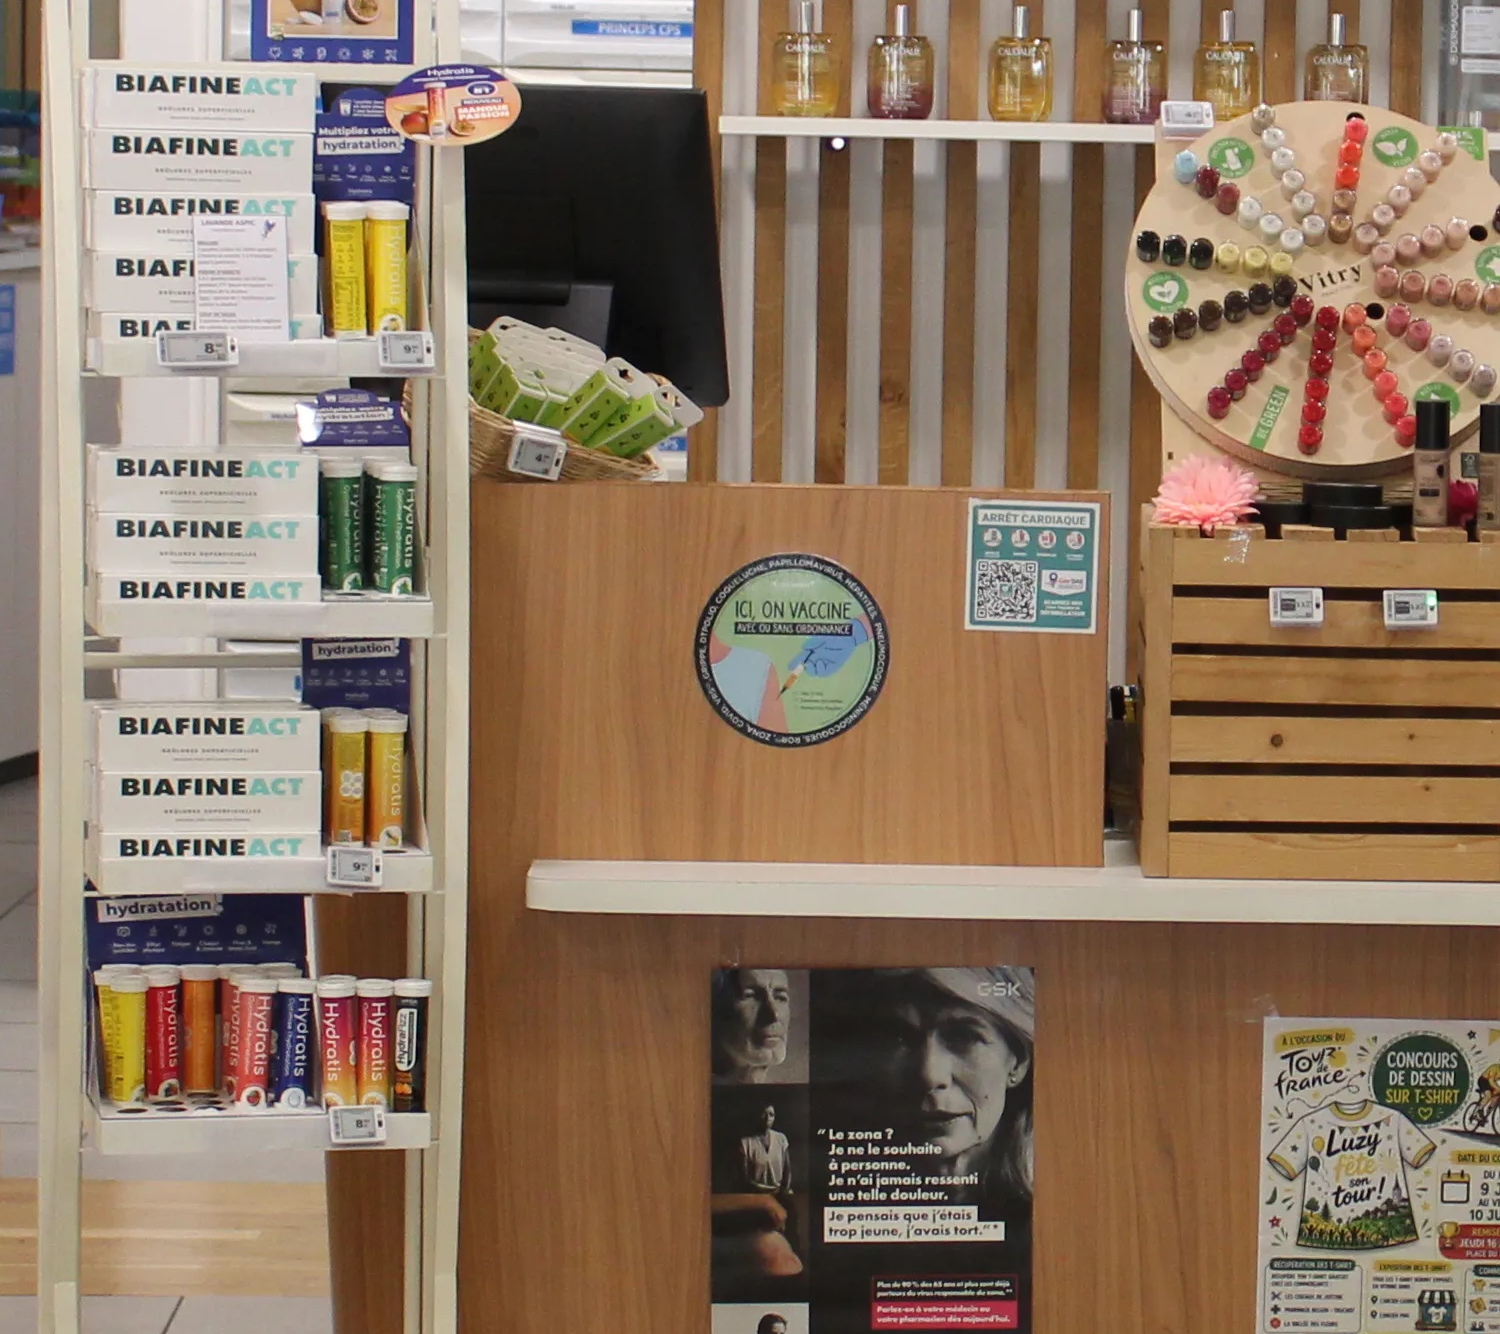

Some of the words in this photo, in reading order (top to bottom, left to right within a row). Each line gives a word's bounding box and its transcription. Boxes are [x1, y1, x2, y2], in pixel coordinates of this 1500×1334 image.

[322, 138, 397, 152] hydratation
[1299, 264, 1363, 291] Vitry
[982, 508, 1018, 525] ARRÊT
[1021, 512, 1087, 527] CARDIAQUE
[735, 600, 755, 622] ICI,
[762, 601, 785, 618] ON
[789, 601, 852, 620] VACCINE
[737, 623, 756, 633] AVEC
[758, 624, 771, 633] OU
[772, 624, 794, 634] SANS
[796, 624, 850, 635] ORDONNANCE
[106, 898, 212, 917] hydratation
[977, 983, 1021, 998] GSK
[324, 1001, 343, 1082] Hydratis
[1387, 1051, 1458, 1068] CONCOURS
[1389, 1071, 1408, 1086] DE
[1410, 1071, 1455, 1086] DESSIN
[1385, 1089, 1411, 1104] SUR
[1414, 1089, 1460, 1104] T-SHIRT
[829, 1129, 844, 1140] Le
[847, 1131, 883, 1140] zona
[829, 1144, 844, 1155] Je
[847, 1146, 864, 1155] ne
[867, 1144, 881, 1155] le
[884, 1143, 942, 1155] souhaite
[1325, 1128, 1382, 1157] Luzy
[829, 1158, 838, 1171] à
[841, 1161, 911, 1174] personne.
[829, 1174, 844, 1186] Je
[876, 1174, 921, 1188] jamais
[924, 1174, 978, 1186] ressenti
[1349, 1177, 1371, 1188] son
[829, 1191, 854, 1201] une
[857, 1189, 887, 1201] telle
[890, 1189, 948, 1201] douleur.
[1481, 1184, 1489, 1196] 9
[829, 1210, 844, 1222] Je
[847, 1210, 900, 1225] pensais
[903, 1213, 929, 1225] que
[1470, 1210, 1483, 1221] 10
[829, 1226, 857, 1239] trop
[860, 1226, 903, 1240] jeune,
